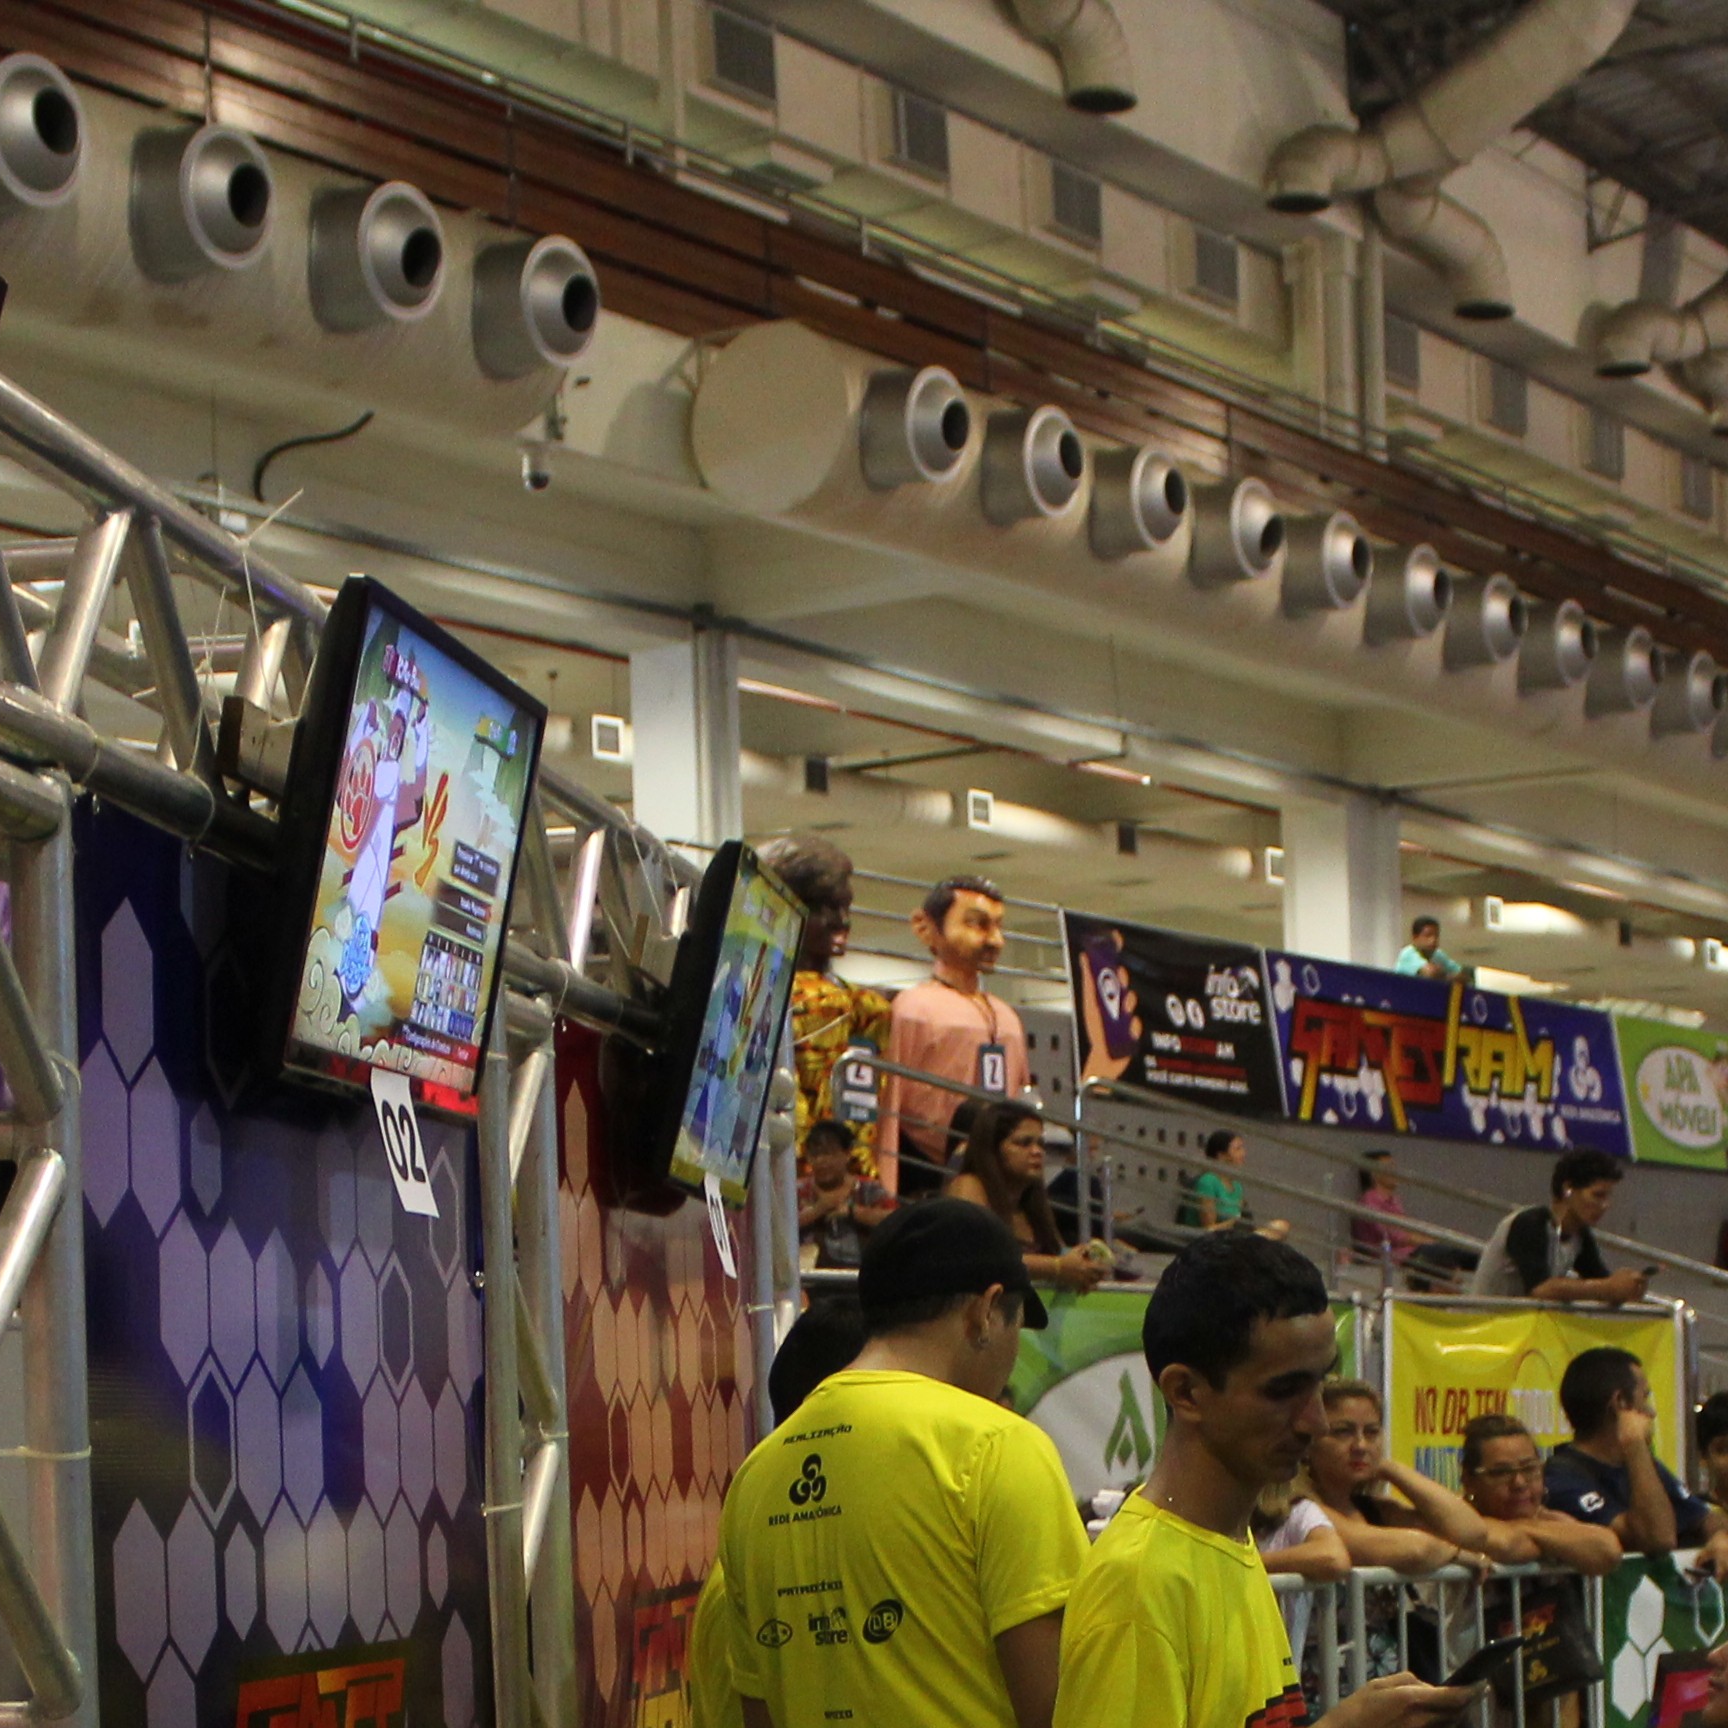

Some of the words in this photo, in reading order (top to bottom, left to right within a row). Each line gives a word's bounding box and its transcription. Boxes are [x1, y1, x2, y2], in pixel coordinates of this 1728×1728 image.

[1211, 995, 1262, 1025] store
[1290, 996, 1447, 1133] GAMES
[1443, 982, 1555, 1100] RAM
[381, 1098, 427, 1185] 02
[1415, 1386, 1438, 1435] NO
